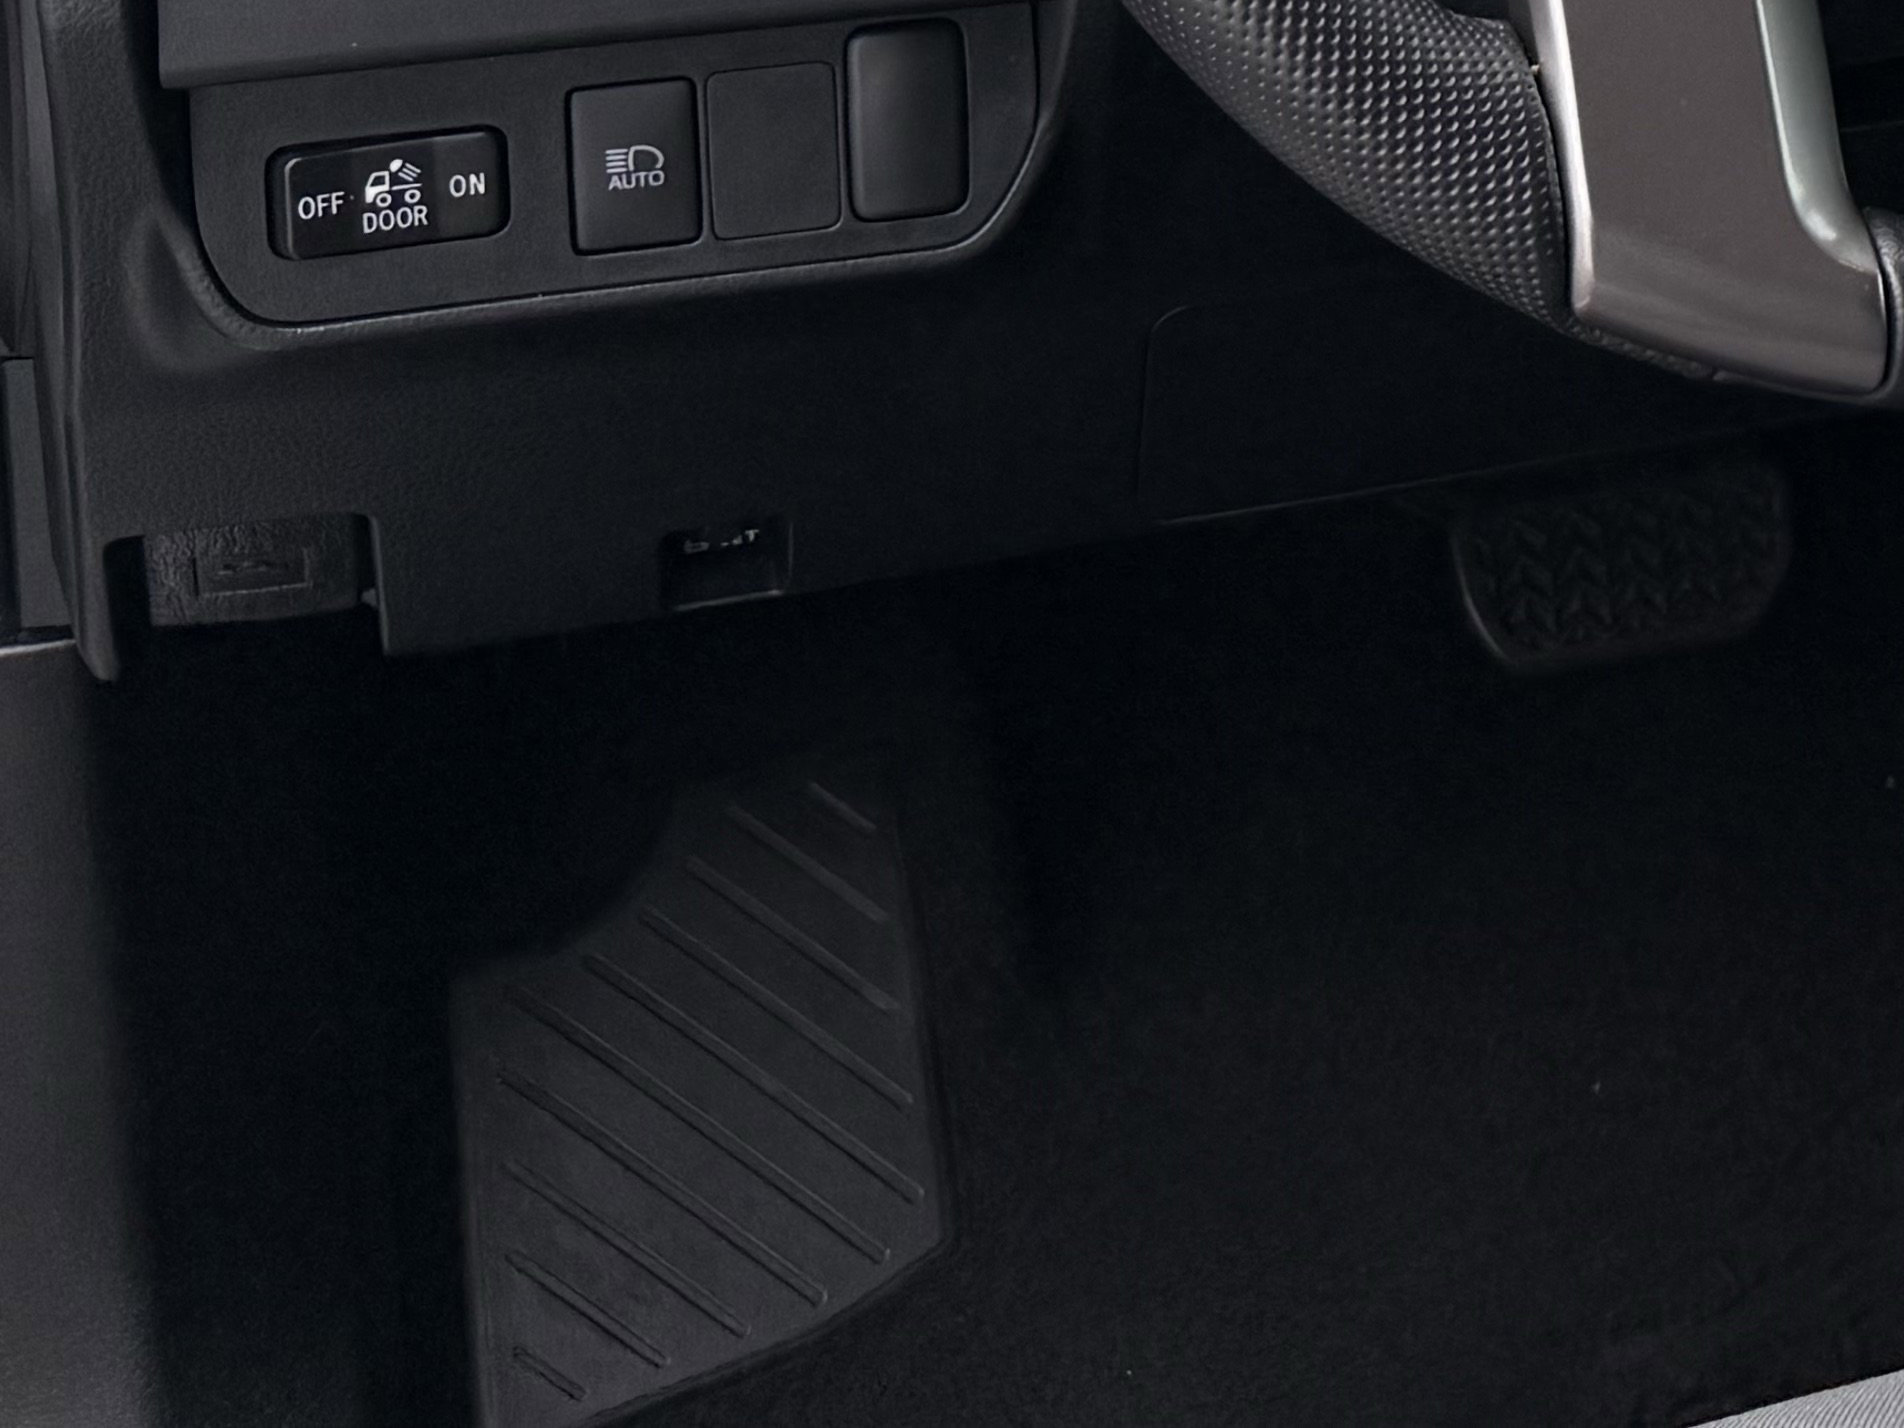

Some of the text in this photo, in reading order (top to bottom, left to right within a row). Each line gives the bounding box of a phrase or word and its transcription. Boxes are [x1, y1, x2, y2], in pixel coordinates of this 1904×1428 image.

[447, 171, 487, 199] ON
[607, 166, 666, 191] AUTO
[297, 190, 346, 222] OFF
[361, 202, 429, 235] DOOR
